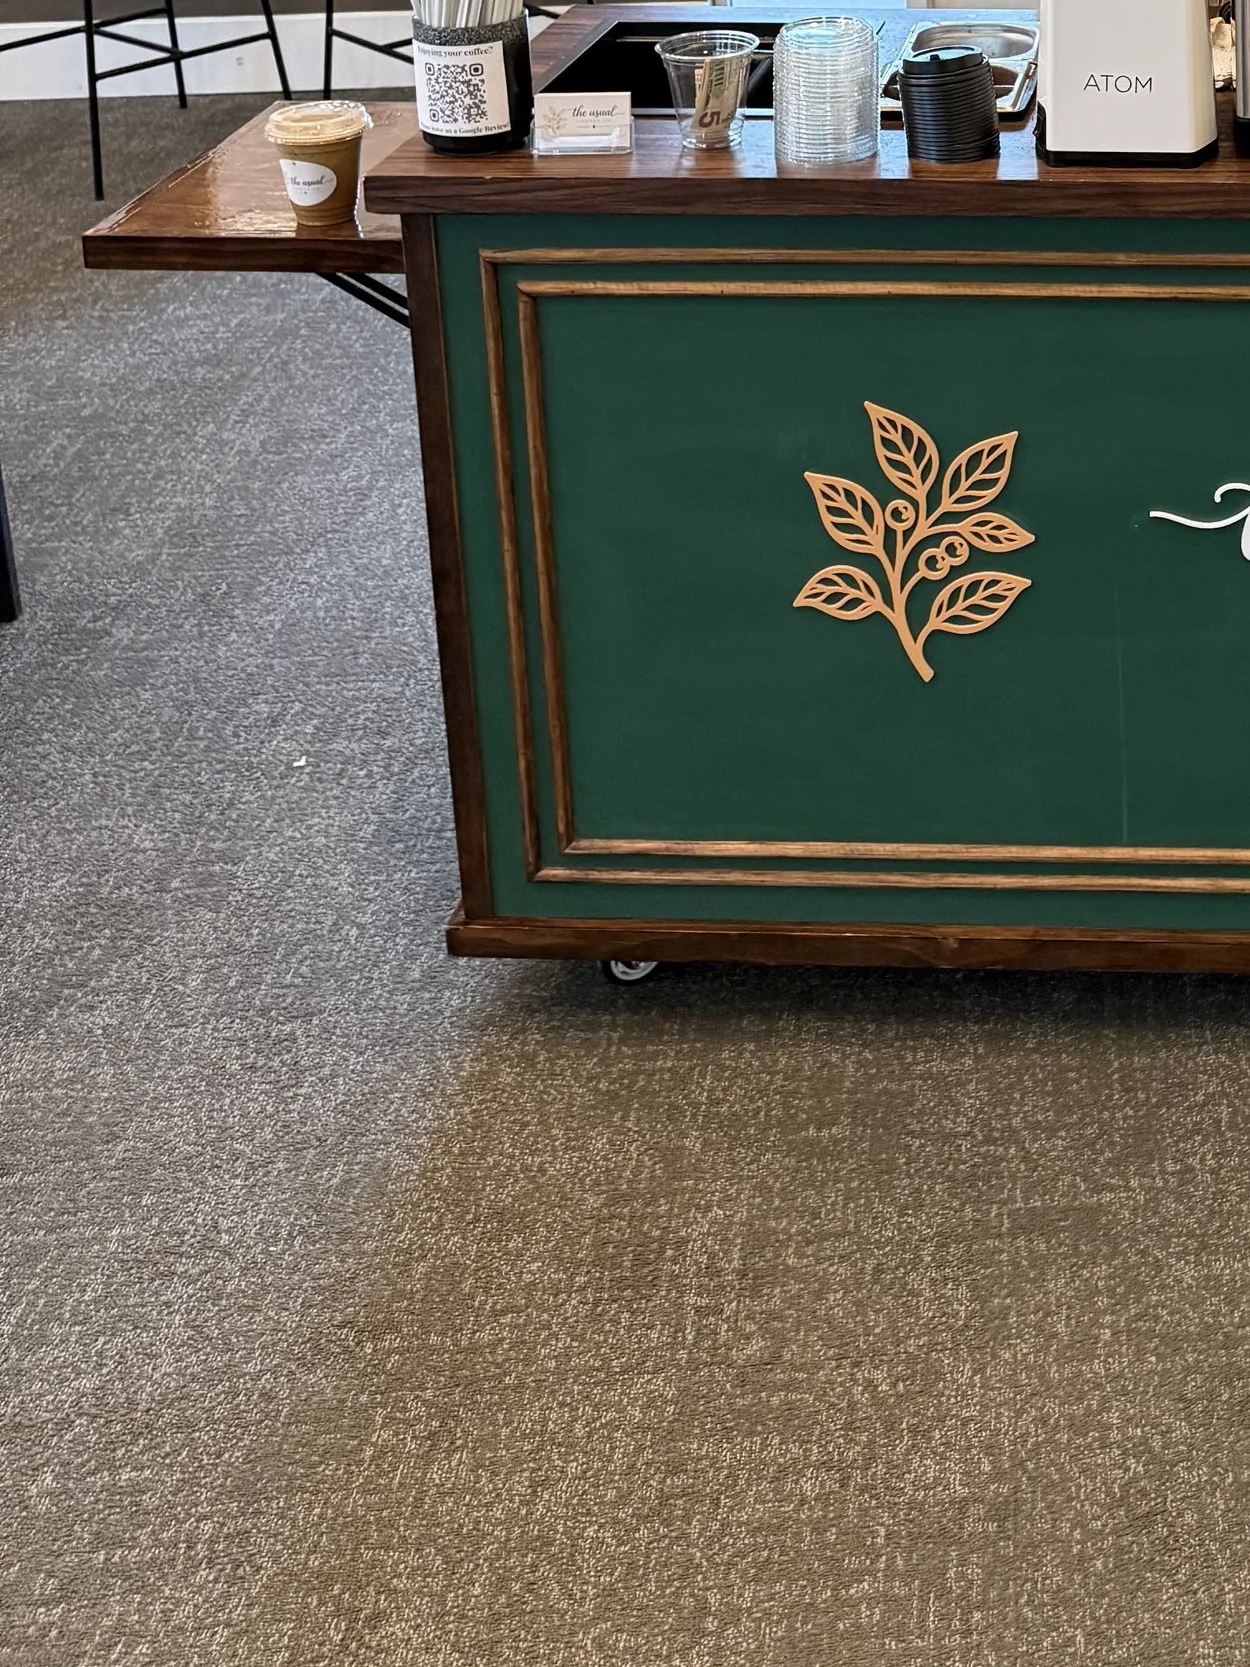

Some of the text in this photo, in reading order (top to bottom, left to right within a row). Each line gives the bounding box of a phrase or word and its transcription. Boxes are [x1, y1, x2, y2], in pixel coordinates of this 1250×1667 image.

[463, 45, 494, 57] coffee?
[1083, 74, 1153, 93] ATOM
[567, 104, 625, 118] the usual
[699, 111, 721, 128] 5
